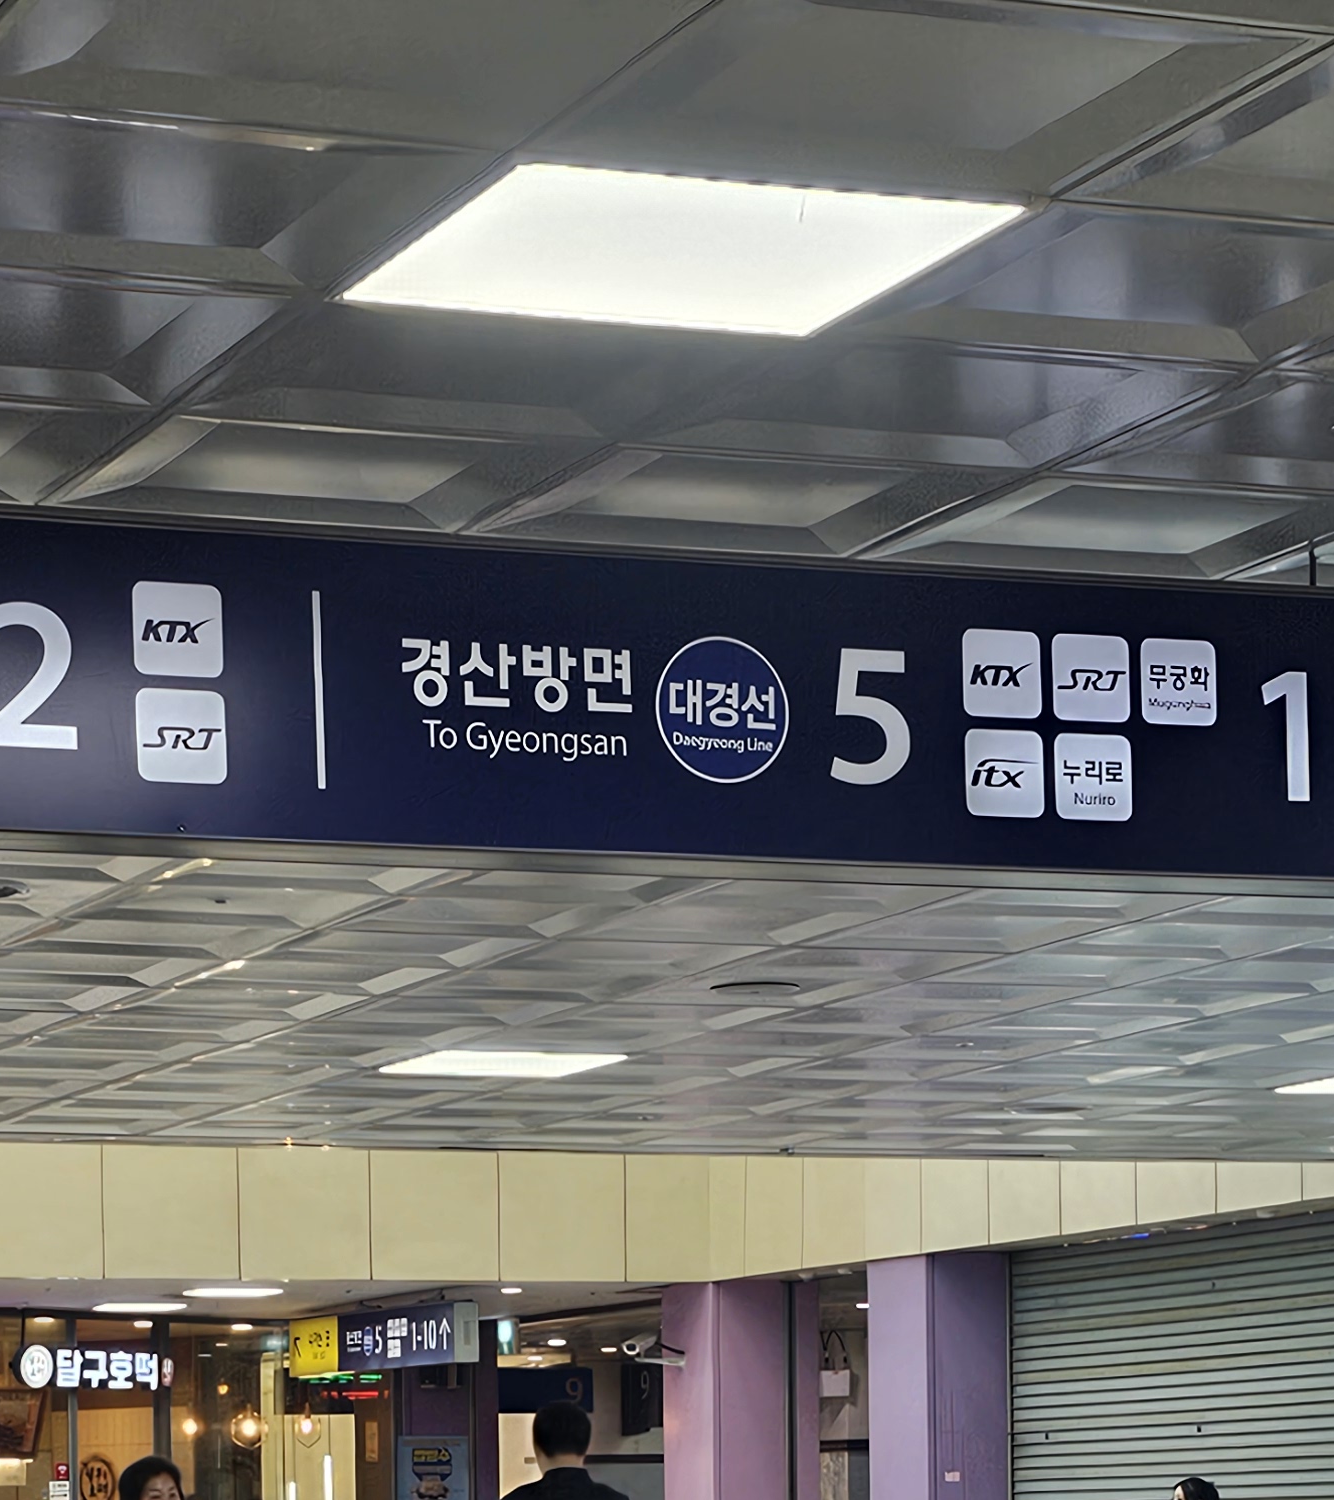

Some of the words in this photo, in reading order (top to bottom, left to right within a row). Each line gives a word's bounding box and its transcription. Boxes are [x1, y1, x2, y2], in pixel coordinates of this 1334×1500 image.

[141, 616, 216, 645] KTX
[401, 637, 633, 713] 경산방면
[970, 662, 1034, 688] KTX
[1057, 668, 1127, 692] SRT
[1148, 663, 1210, 693] 무궁화
[668, 680, 777, 730] 대경선
[830, 647, 911, 785] 5
[141, 726, 222, 751] SRT
[423, 719, 458, 750] To
[466, 722, 628, 761] Gyeongsan
[747, 737, 774, 752] Line
[971, 758, 1043, 789] itx
[1062, 759, 1124, 785] 누리로
[1073, 791, 1116, 807] Nuriro
